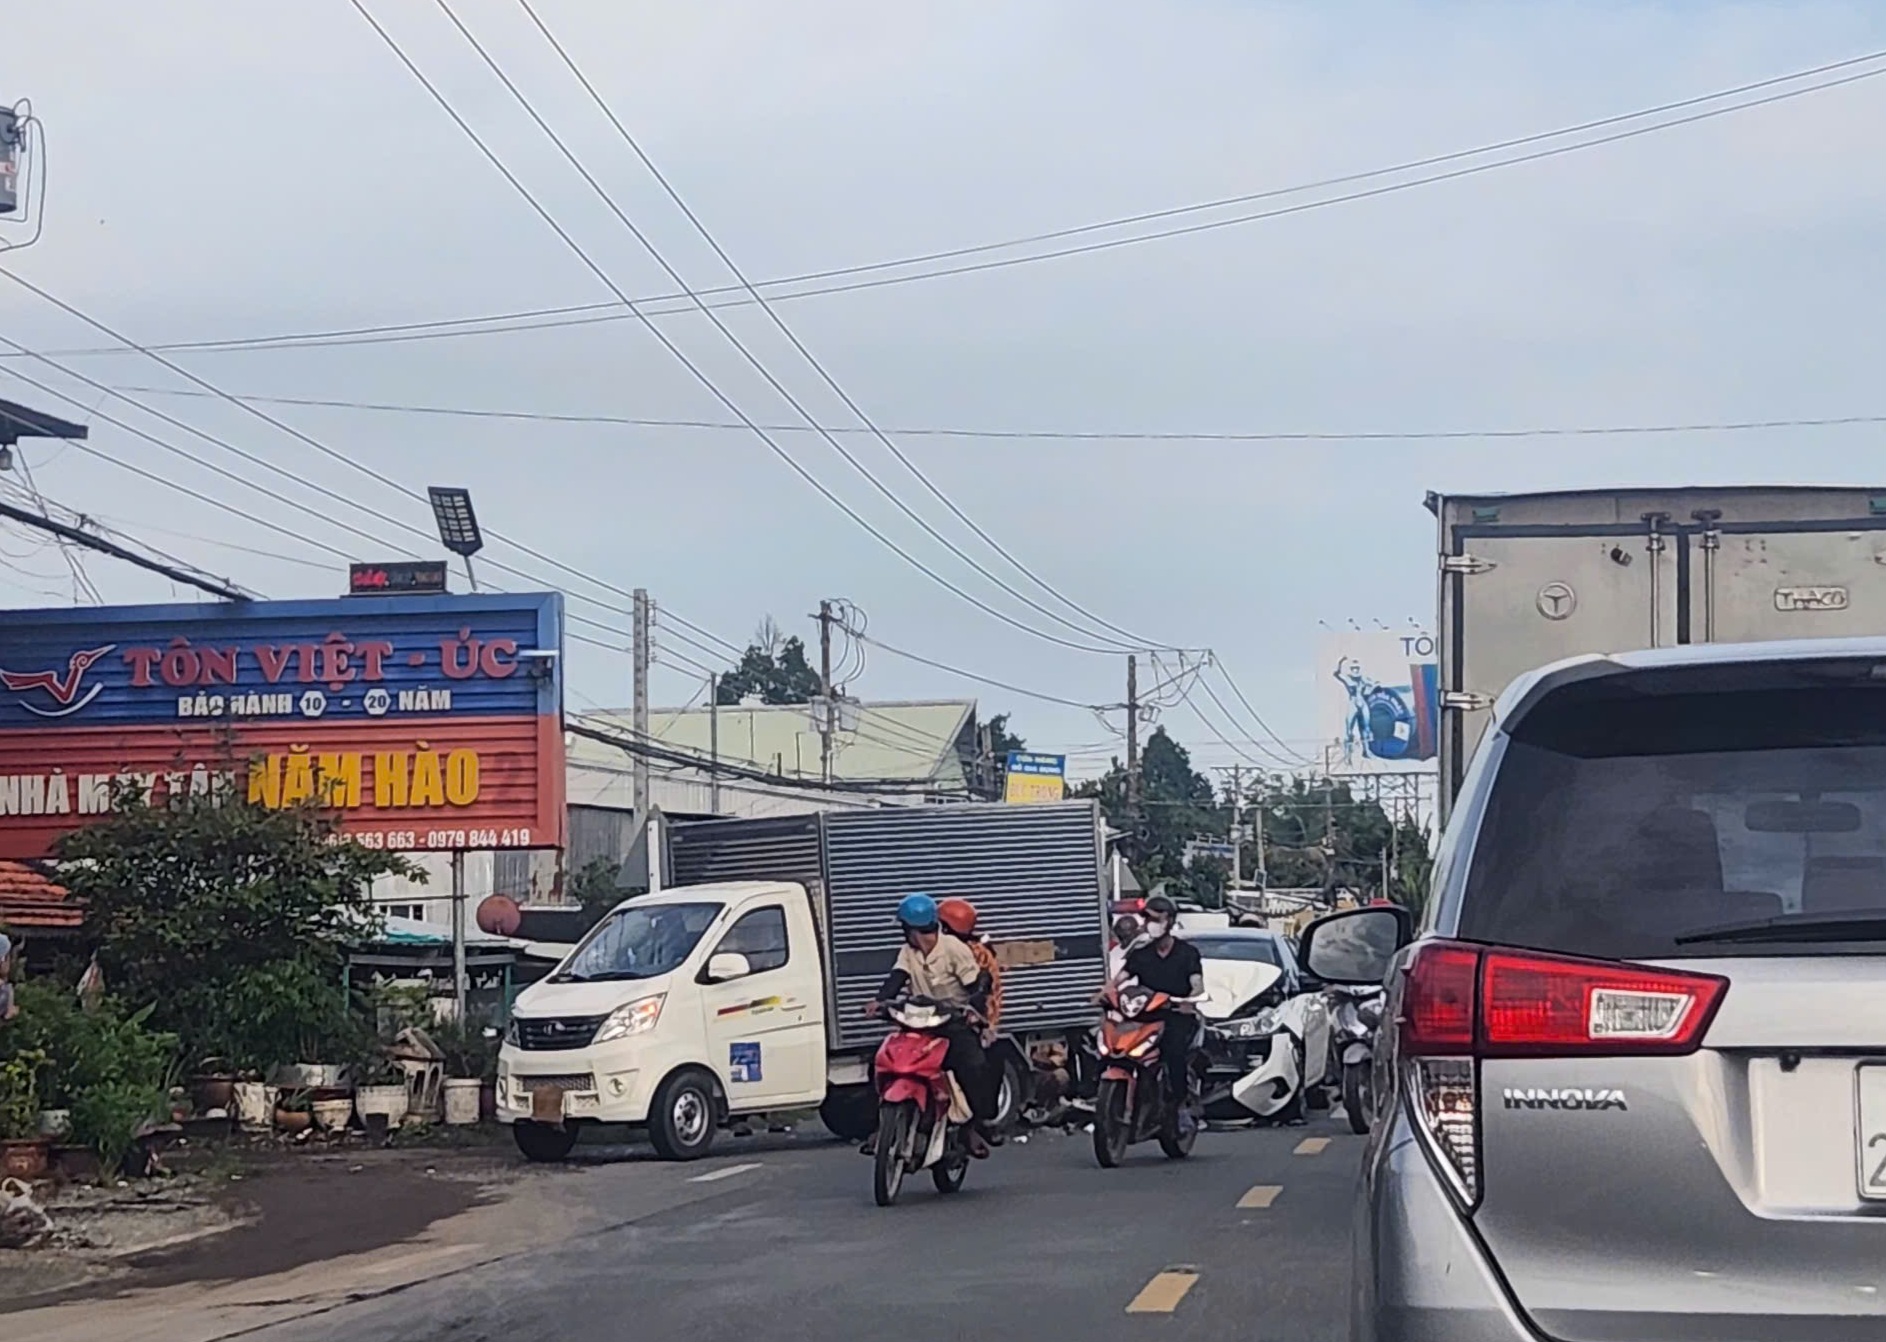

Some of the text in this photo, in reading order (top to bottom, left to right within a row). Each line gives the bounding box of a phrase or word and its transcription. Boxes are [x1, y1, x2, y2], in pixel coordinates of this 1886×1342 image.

[1400, 631, 1438, 656] TÔ
[123, 635, 239, 687] TÔN
[255, 630, 393, 692] VIỆT
[439, 625, 517, 679] ÚC
[231, 690, 294, 715] HÀNH
[304, 697, 322, 711] 10
[368, 694, 387, 709] 20
[398, 685, 451, 711] NĂM
[0, 767, 71, 815] NHÀ
[248, 743, 362, 810] NĂM
[375, 740, 480, 807] HÀO
[387, 831, 415, 849] 663
[427, 830, 465, 848] 0979
[469, 829, 497, 847] 844
[501, 828, 530, 846] 419
[1503, 1088, 1628, 1111] INNOVA
